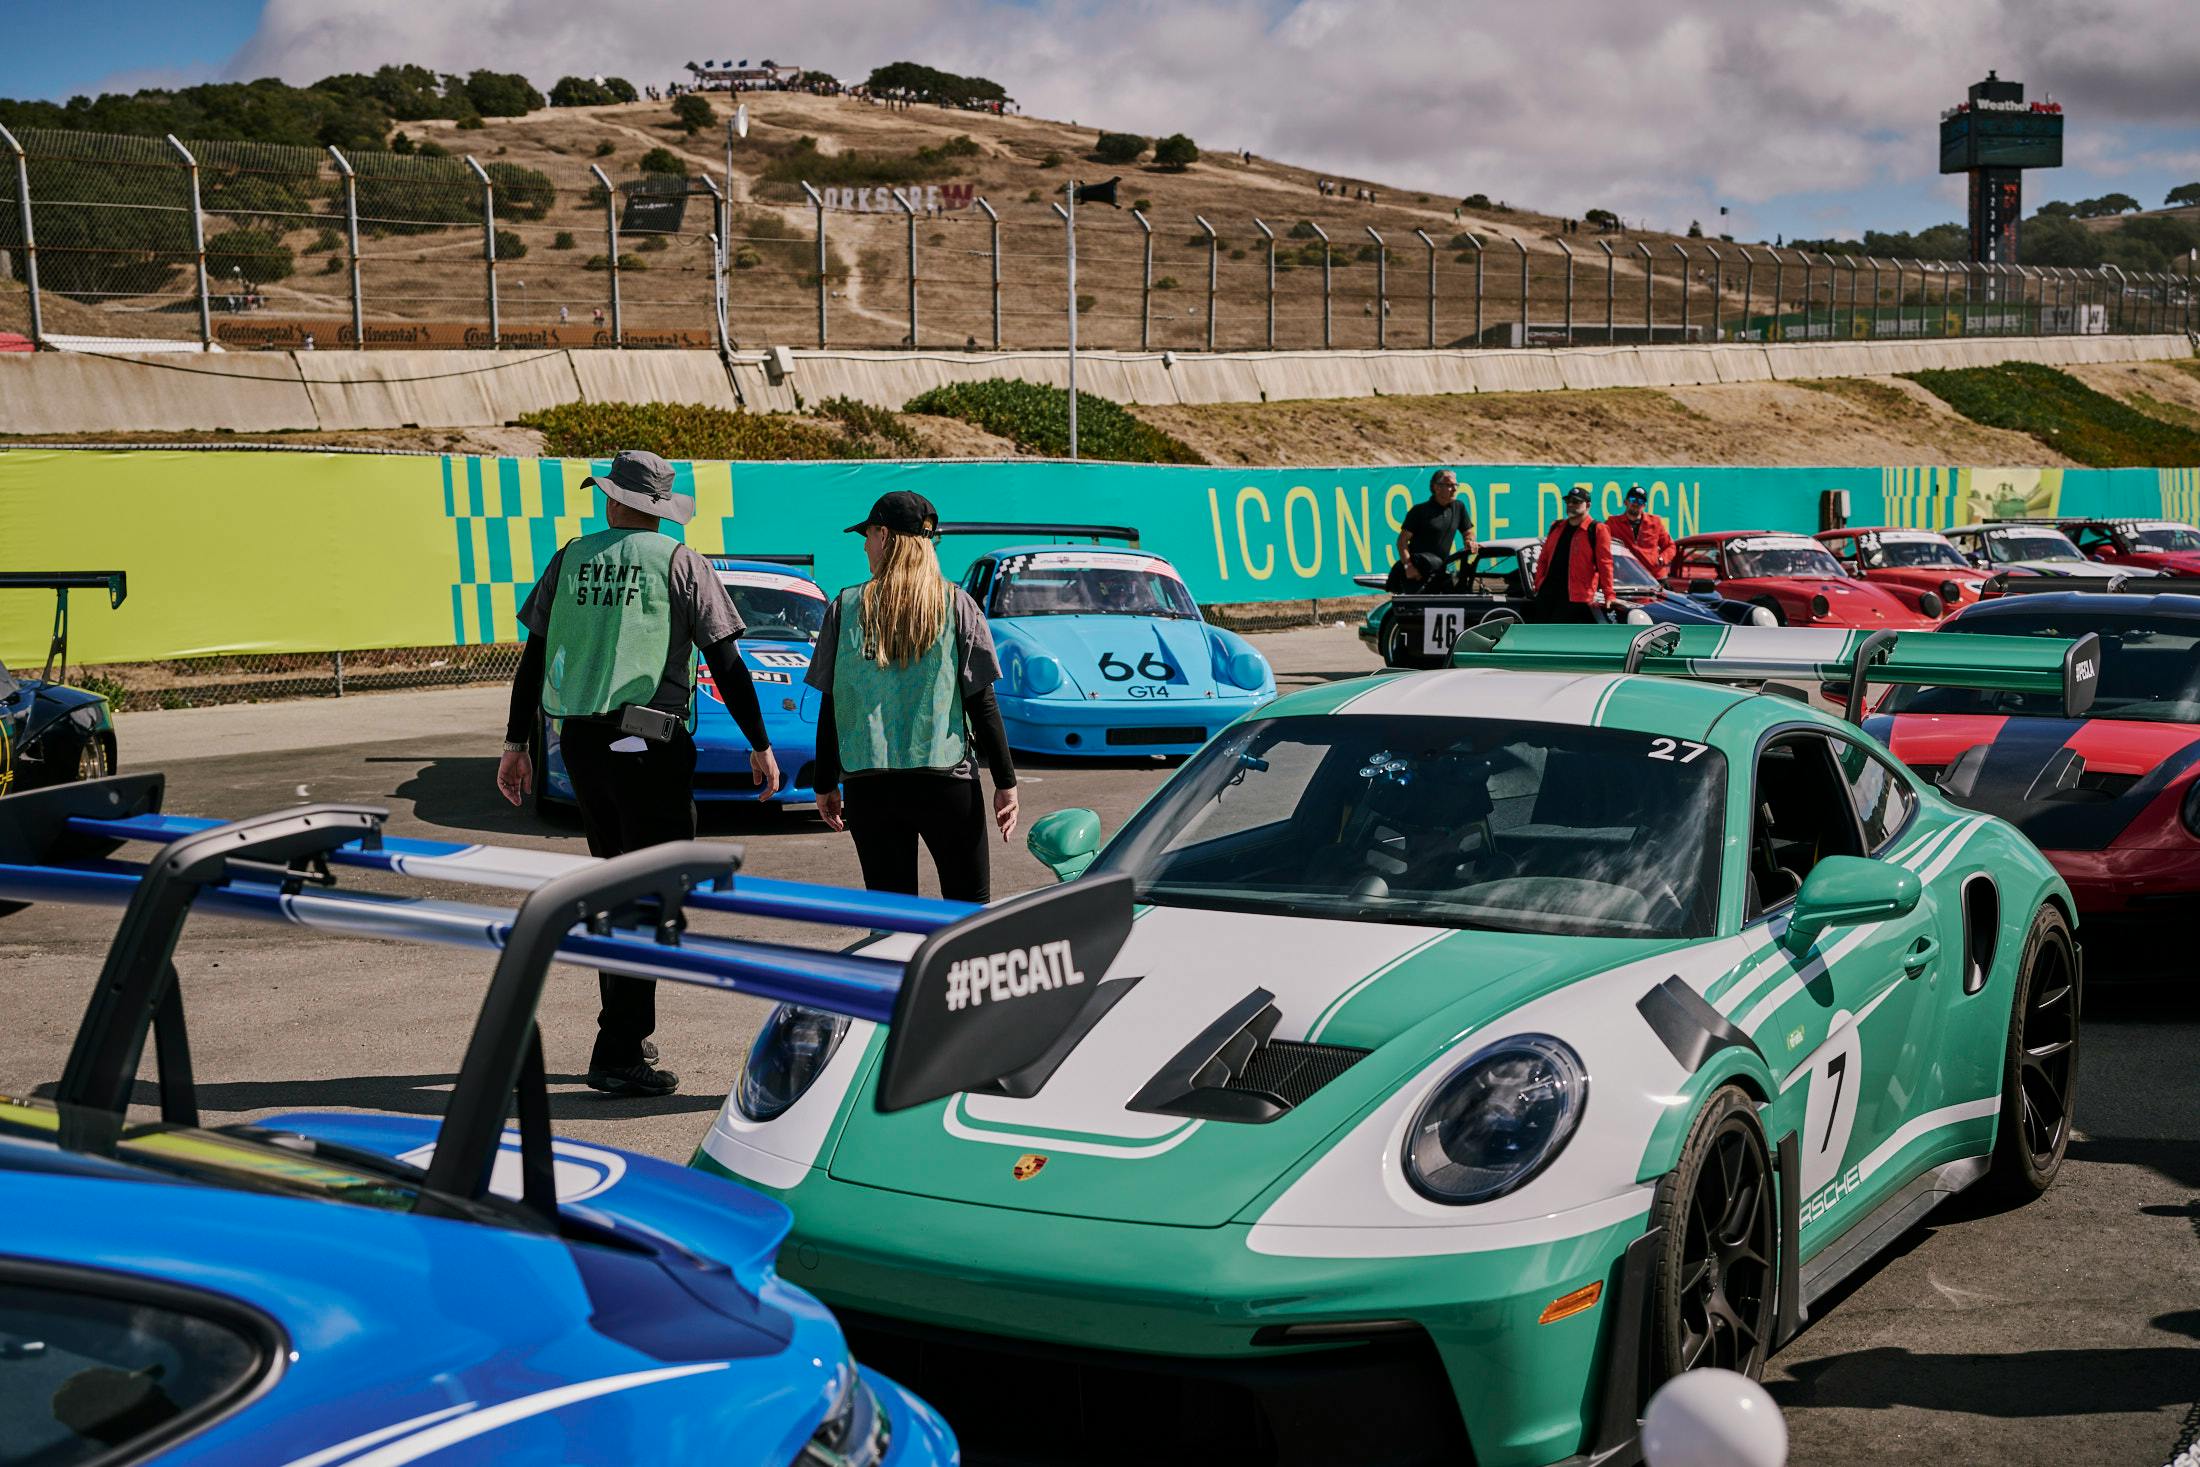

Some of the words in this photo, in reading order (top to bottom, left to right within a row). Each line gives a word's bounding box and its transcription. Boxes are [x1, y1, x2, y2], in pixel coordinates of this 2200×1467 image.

[338, 325, 417, 342] Coinental
[1207, 484, 1413, 580] ICONS
[1538, 481, 1700, 540] DSGN
[578, 563, 642, 583] EVENT
[577, 586, 639, 607] STAFF
[1431, 613, 1458, 648] 46
[1098, 652, 1176, 682] 66
[1127, 685, 1170, 698] GT4
[1648, 738, 1708, 763] 27
[946, 939, 1085, 1011] #PECATL
[1821, 1051, 1847, 1154] 7
[1799, 1164, 1861, 1231] RSCHE
